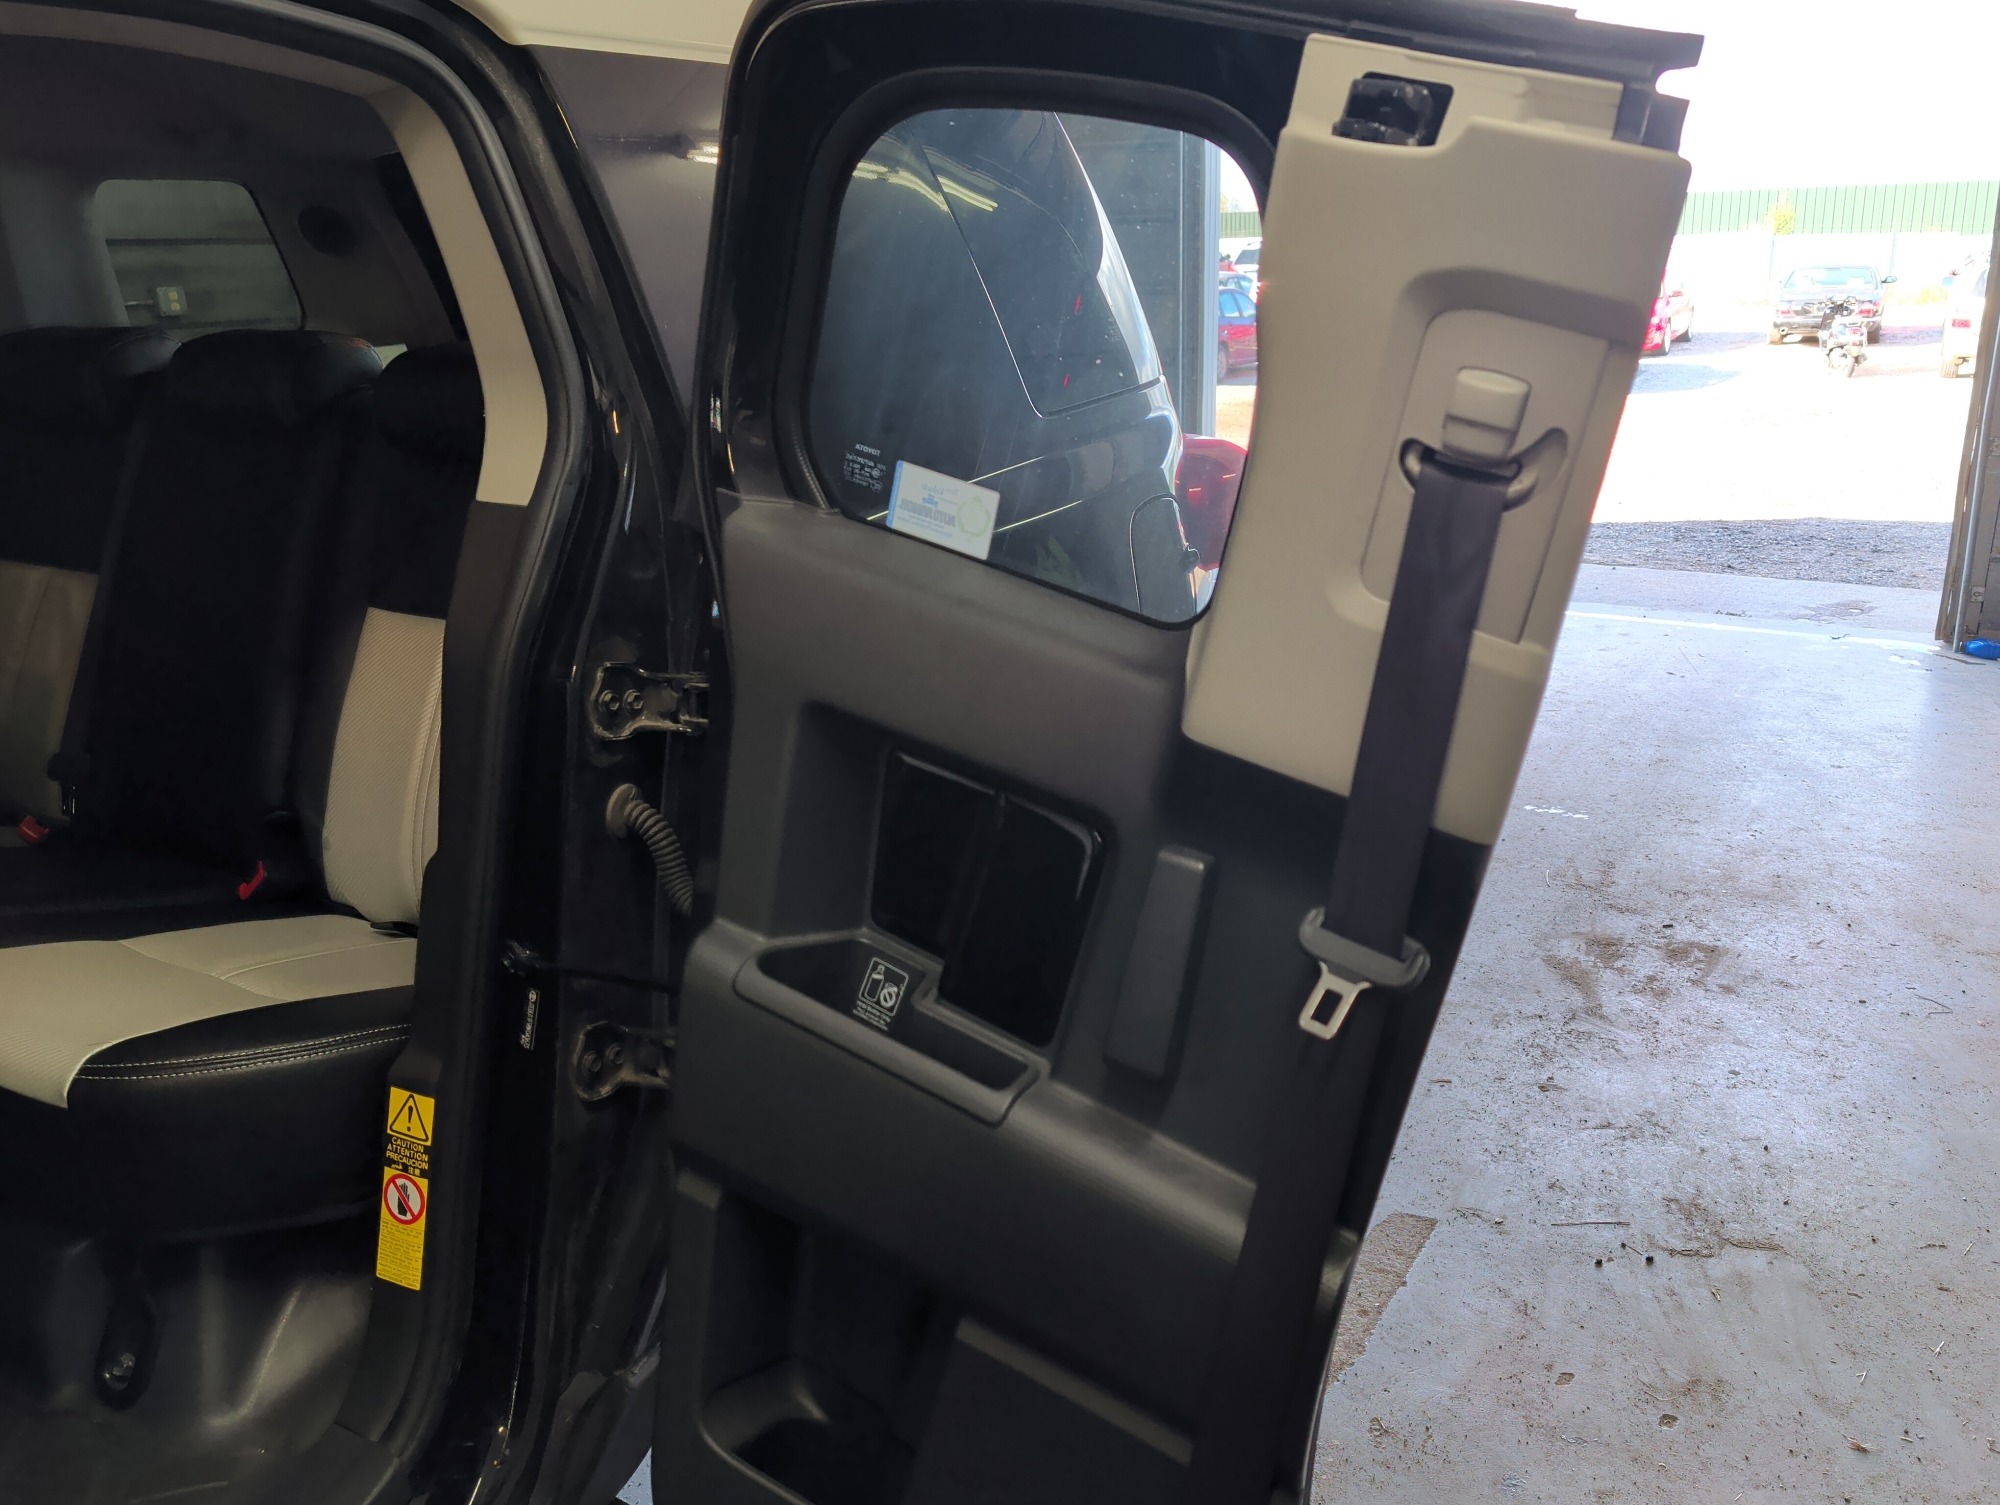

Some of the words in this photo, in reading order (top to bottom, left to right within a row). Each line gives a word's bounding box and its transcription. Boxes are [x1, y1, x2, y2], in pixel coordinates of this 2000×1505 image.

[387, 1143, 428, 1162] ATTENTION
[391, 1136, 424, 1152] CAUTION
[385, 1150, 429, 1170] PRECAUCION
